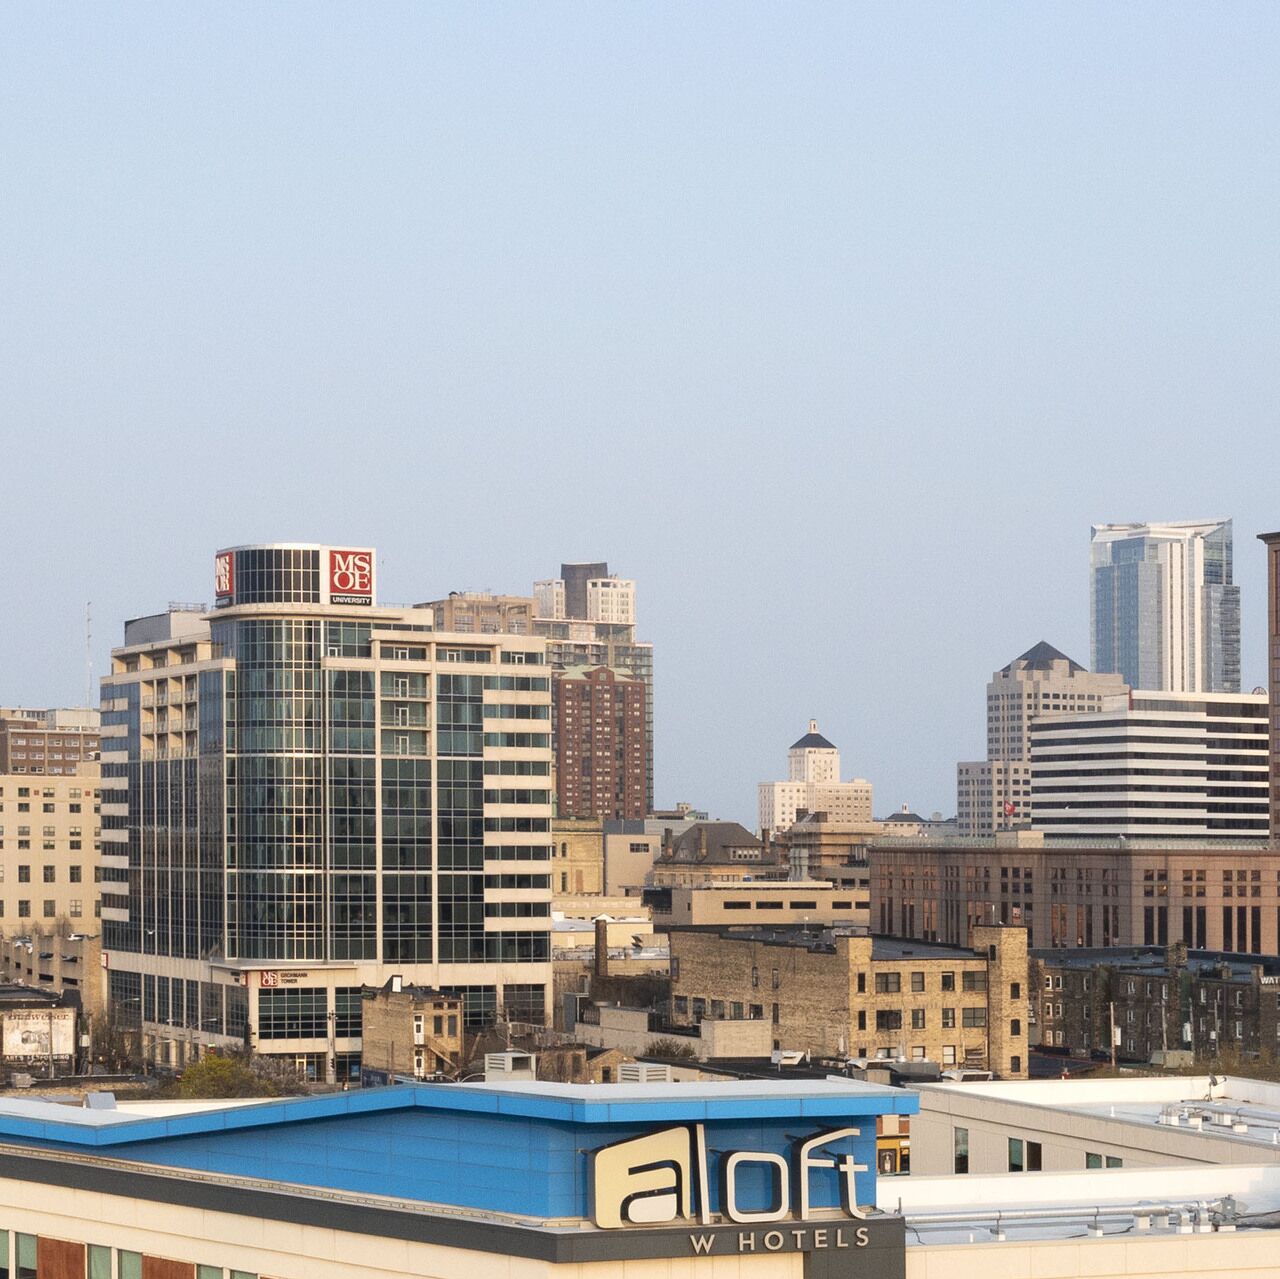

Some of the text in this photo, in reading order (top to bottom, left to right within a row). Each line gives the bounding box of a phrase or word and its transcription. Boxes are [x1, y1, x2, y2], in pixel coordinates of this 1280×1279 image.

[333, 553, 370, 573] MS
[333, 571, 370, 590] OE
[332, 596, 371, 604] UNIVERSITY
[594, 1123, 869, 1229] aloft
[690, 1226, 870, 1255] W HOTELS
